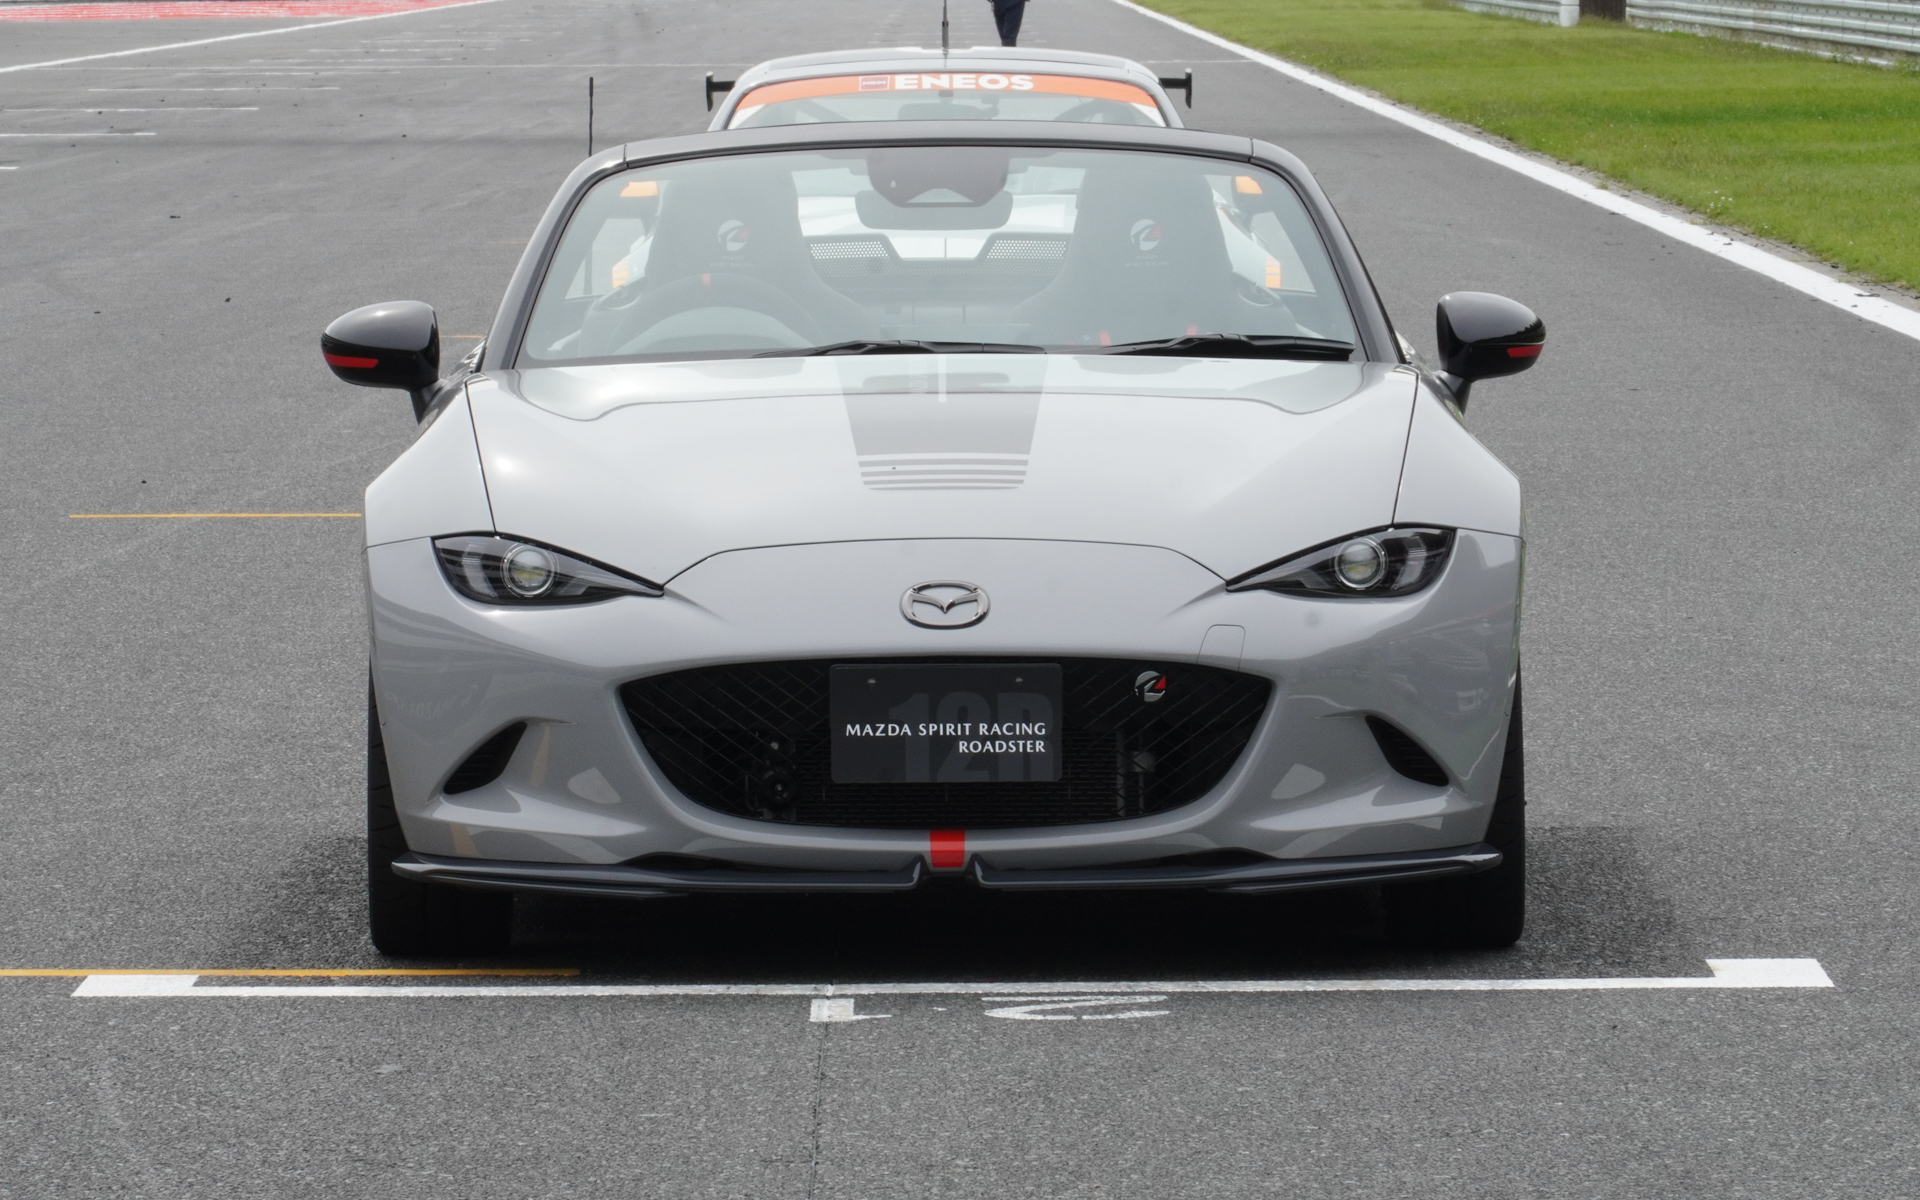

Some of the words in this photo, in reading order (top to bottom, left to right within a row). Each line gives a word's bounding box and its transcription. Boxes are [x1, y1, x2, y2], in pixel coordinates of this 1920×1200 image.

[894, 74, 1034, 90] ENEOS
[845, 724, 912, 737] MAZDA
[918, 723, 972, 736] SPIRIT
[979, 723, 1046, 736] RACING
[888, 691, 1054, 782] 12R
[958, 740, 1046, 753] ROADSTER
